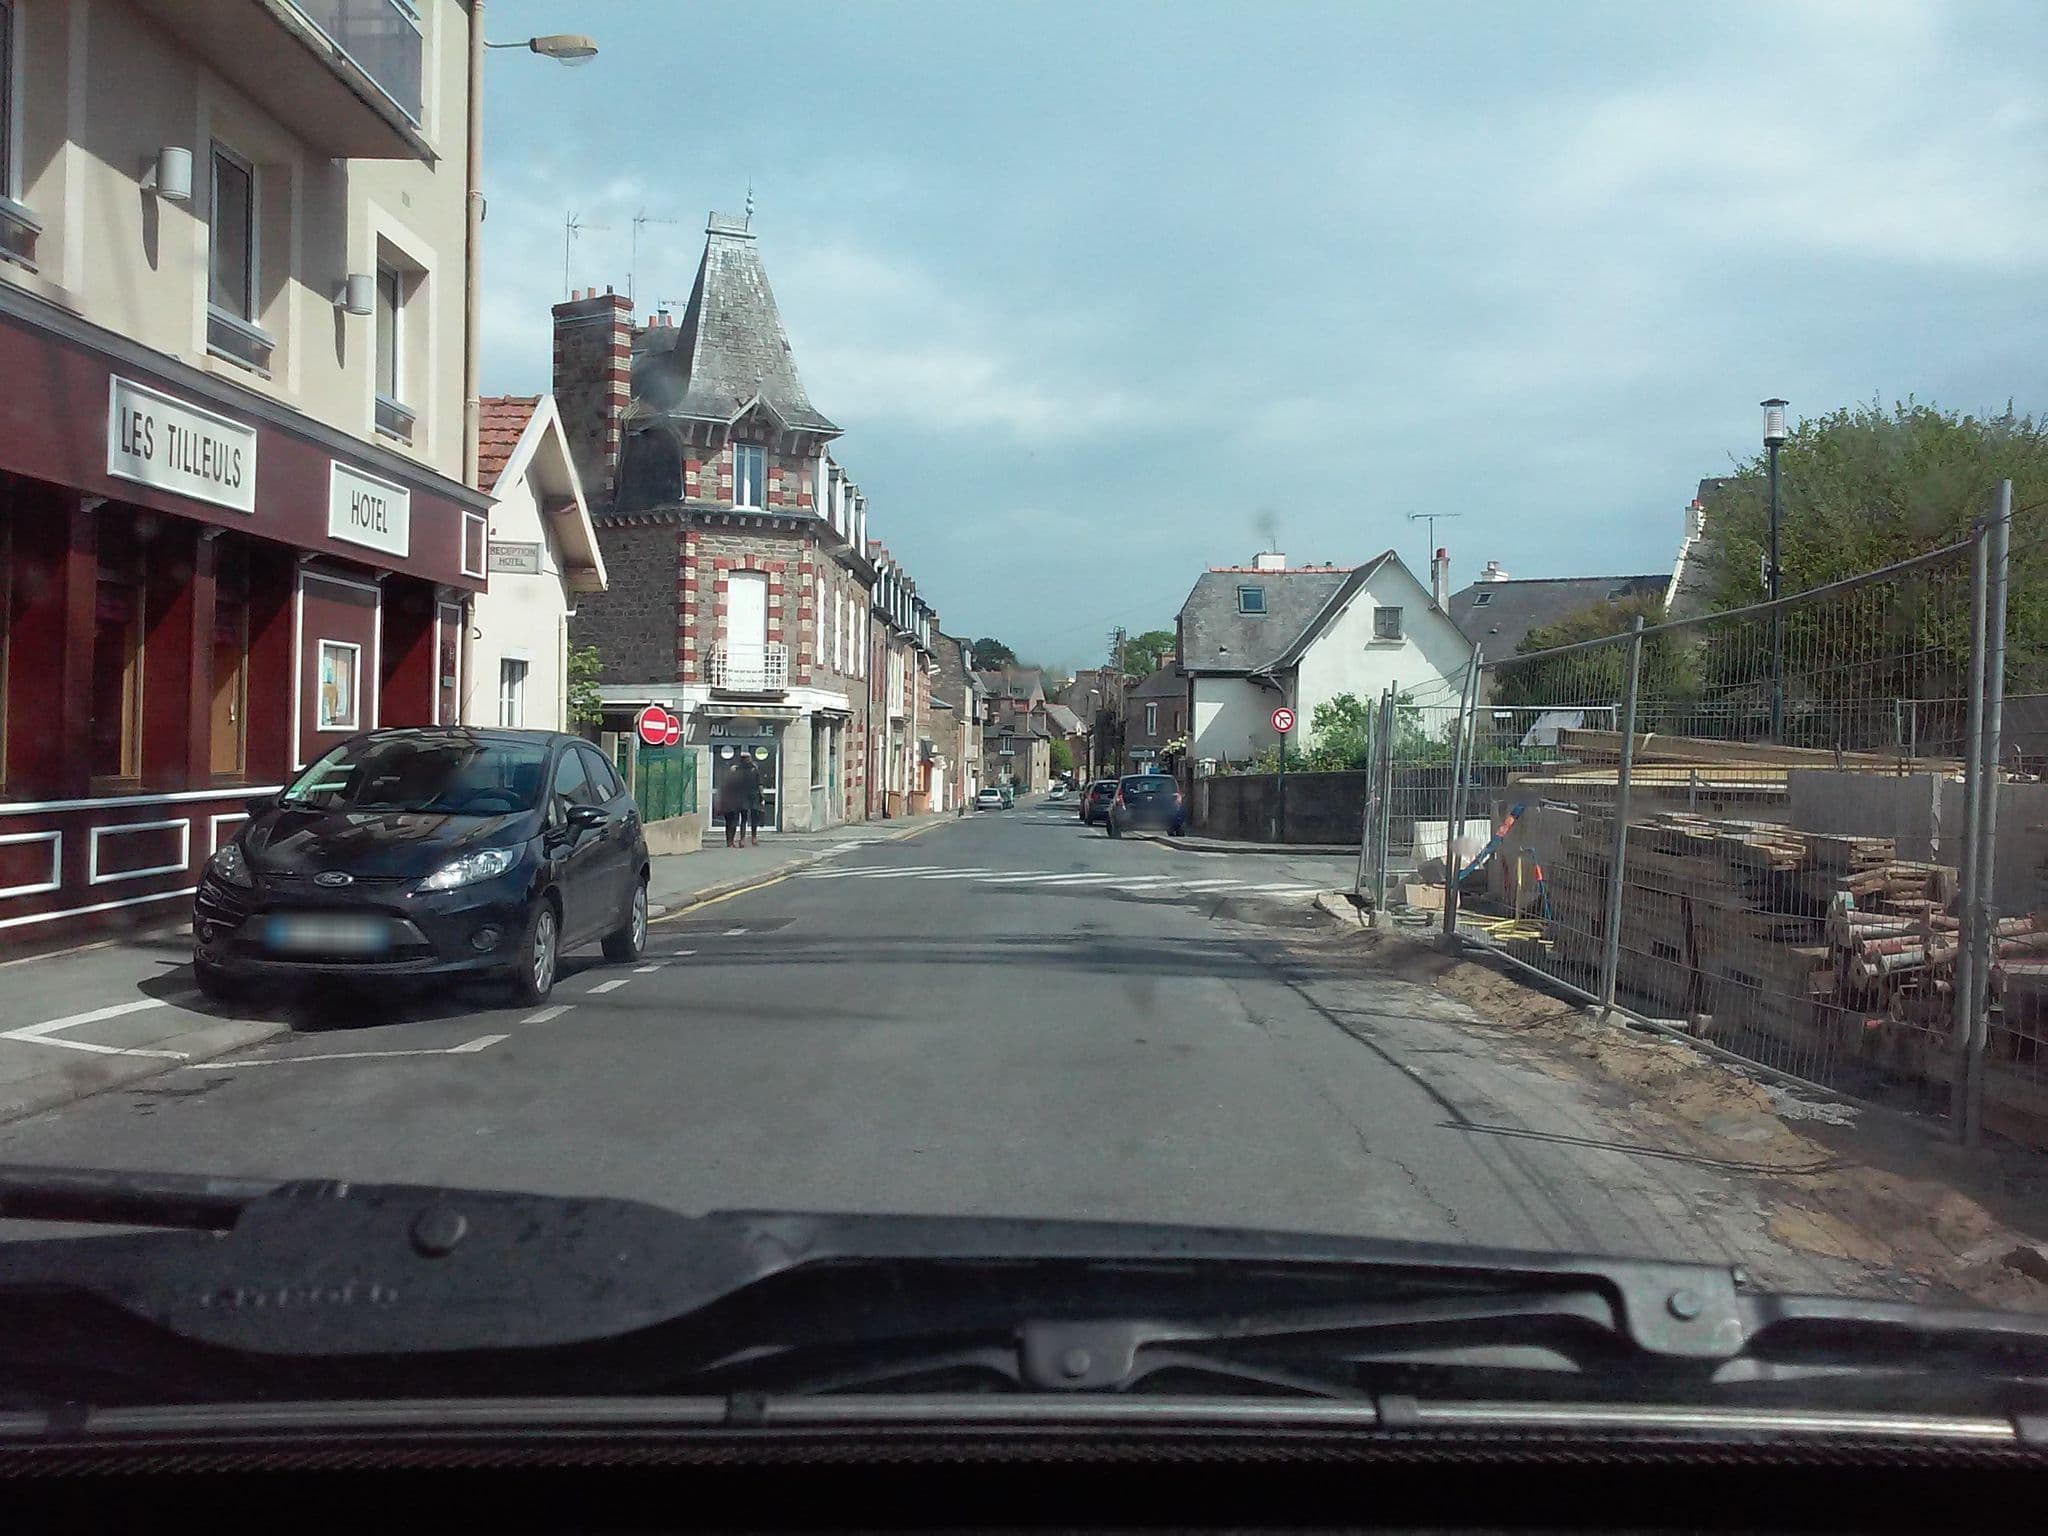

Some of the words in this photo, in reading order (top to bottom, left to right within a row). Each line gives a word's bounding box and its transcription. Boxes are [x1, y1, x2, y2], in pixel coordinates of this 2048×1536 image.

[121, 407, 154, 460] LES
[167, 423, 241, 488] TILLEULS
[350, 489, 388, 534] HOTEL
